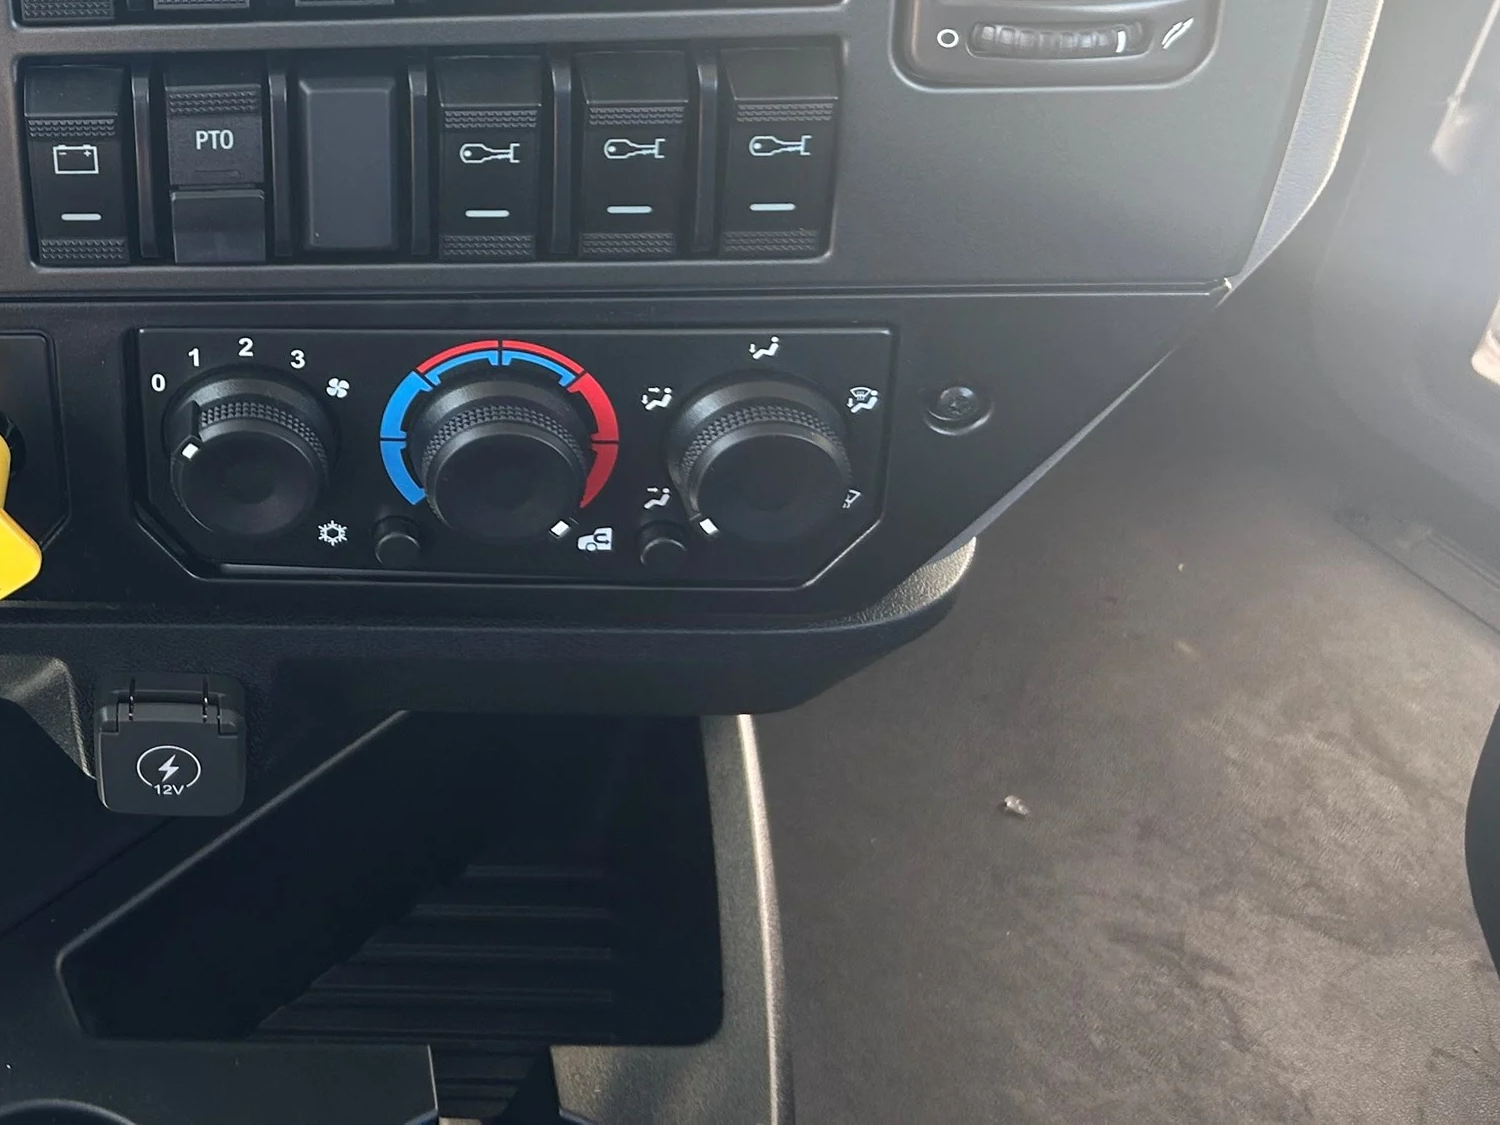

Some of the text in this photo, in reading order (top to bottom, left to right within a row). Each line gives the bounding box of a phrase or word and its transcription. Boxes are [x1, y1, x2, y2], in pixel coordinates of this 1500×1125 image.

[195, 129, 234, 150] PTO
[188, 347, 200, 367] 1
[238, 337, 254, 357] 2
[290, 349, 306, 369] 3
[151, 373, 166, 392] 0
[154, 784, 185, 796] 12V
